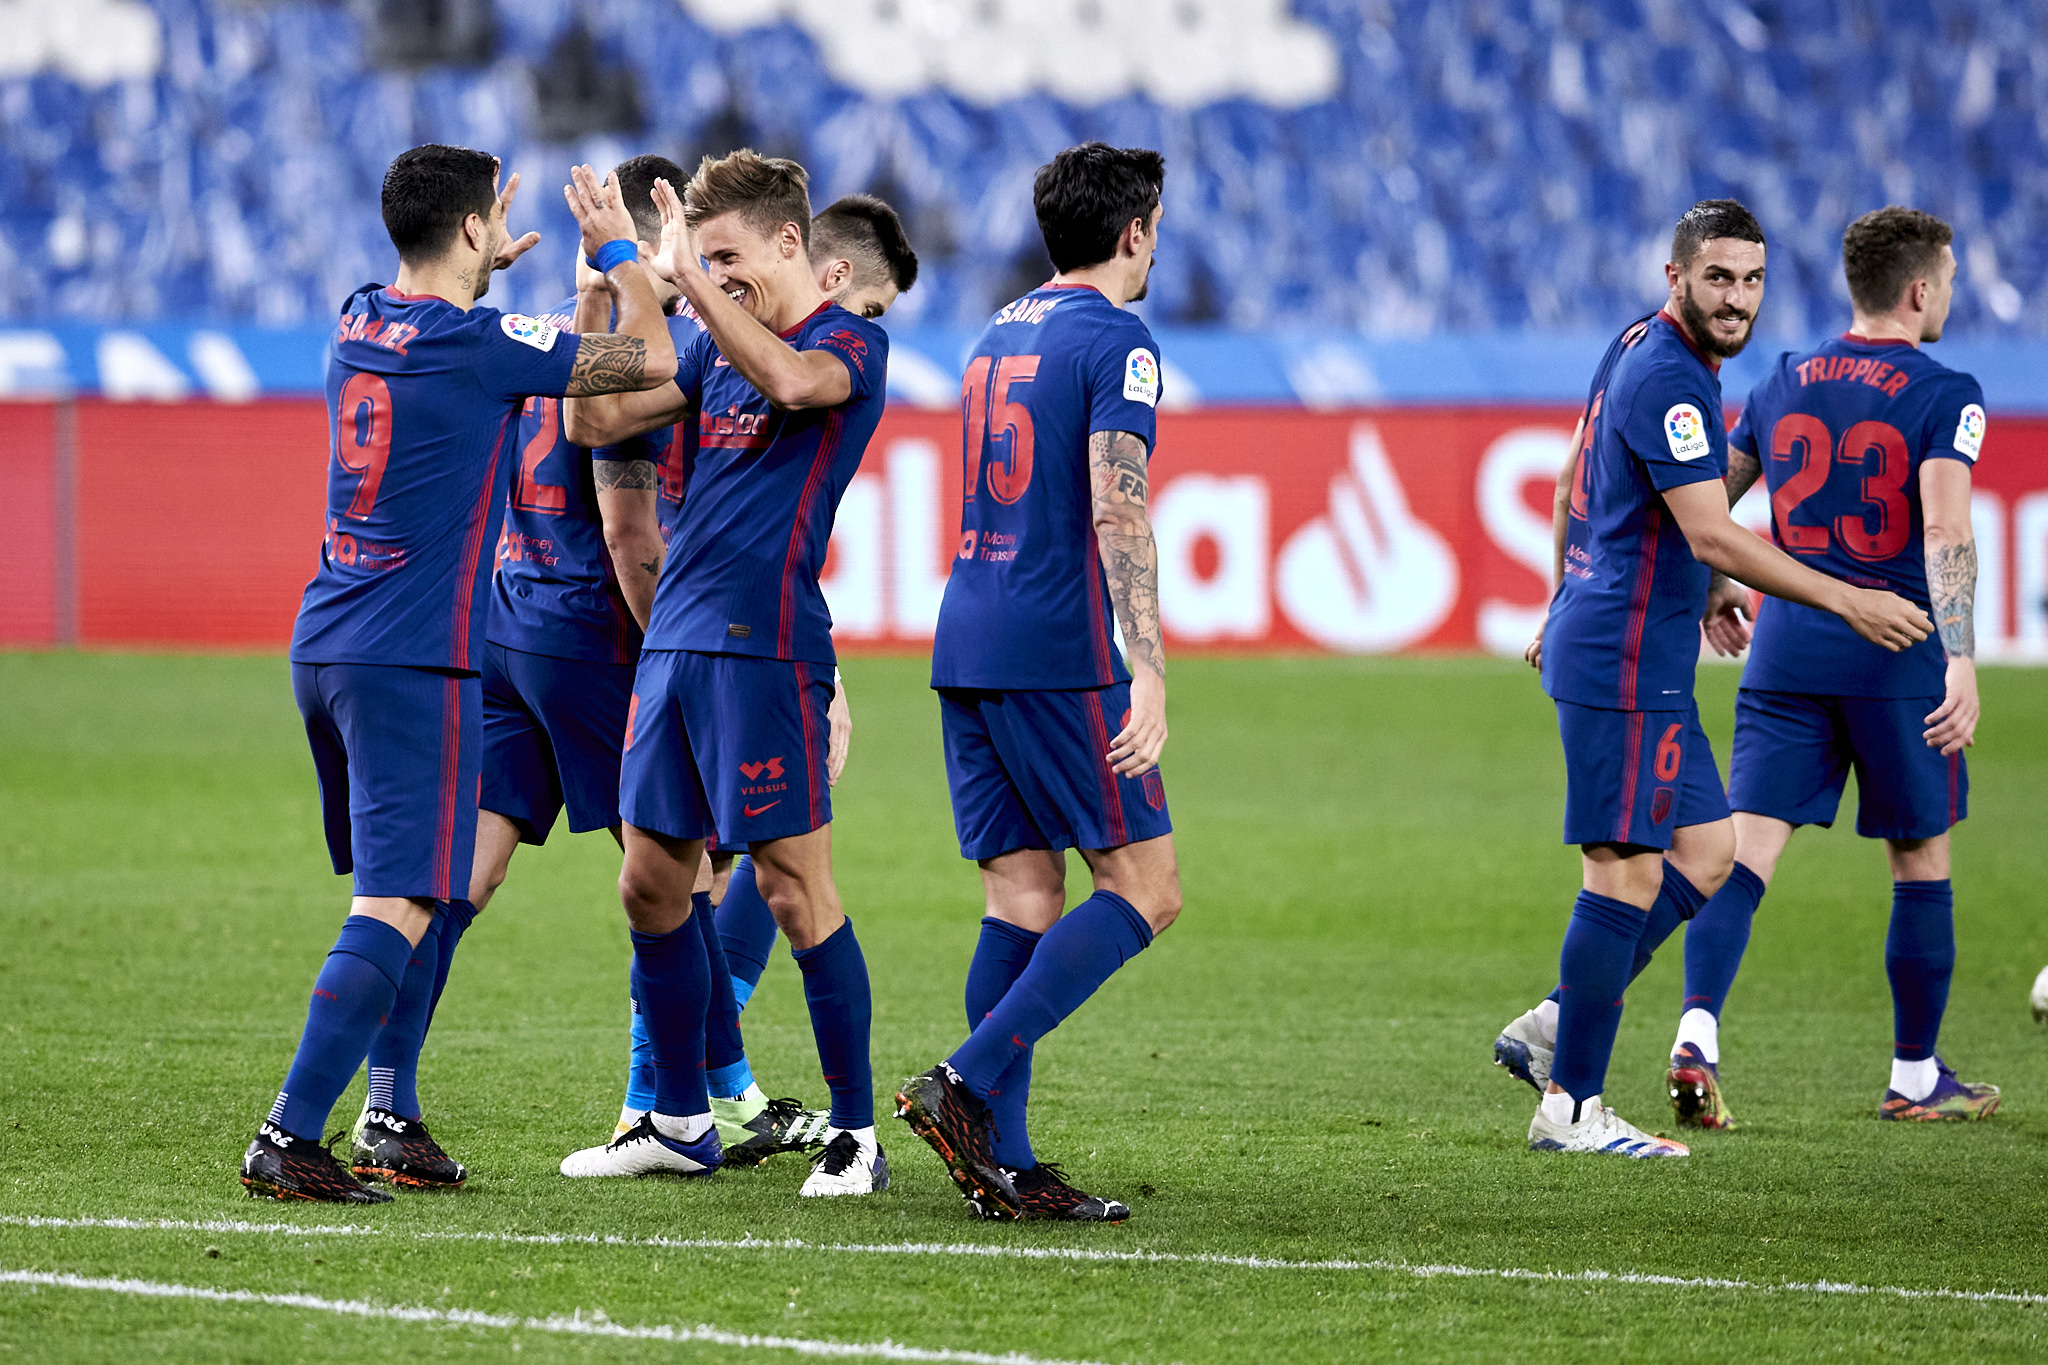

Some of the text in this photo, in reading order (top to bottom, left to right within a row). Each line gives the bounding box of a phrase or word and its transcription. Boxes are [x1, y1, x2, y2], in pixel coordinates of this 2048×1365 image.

[1128, 384, 1155, 399] LaLiga
[1796, 356, 1909, 397] TRIPPIER
[336, 372, 393, 521] 9
[510, 396, 566, 516] 2
[961, 355, 1042, 505] 15
[1675, 441, 1705, 454] LaLiga
[1770, 413, 1910, 562] 23
[1653, 723, 1683, 782] 6
[741, 782, 787, 795] VERSUS
